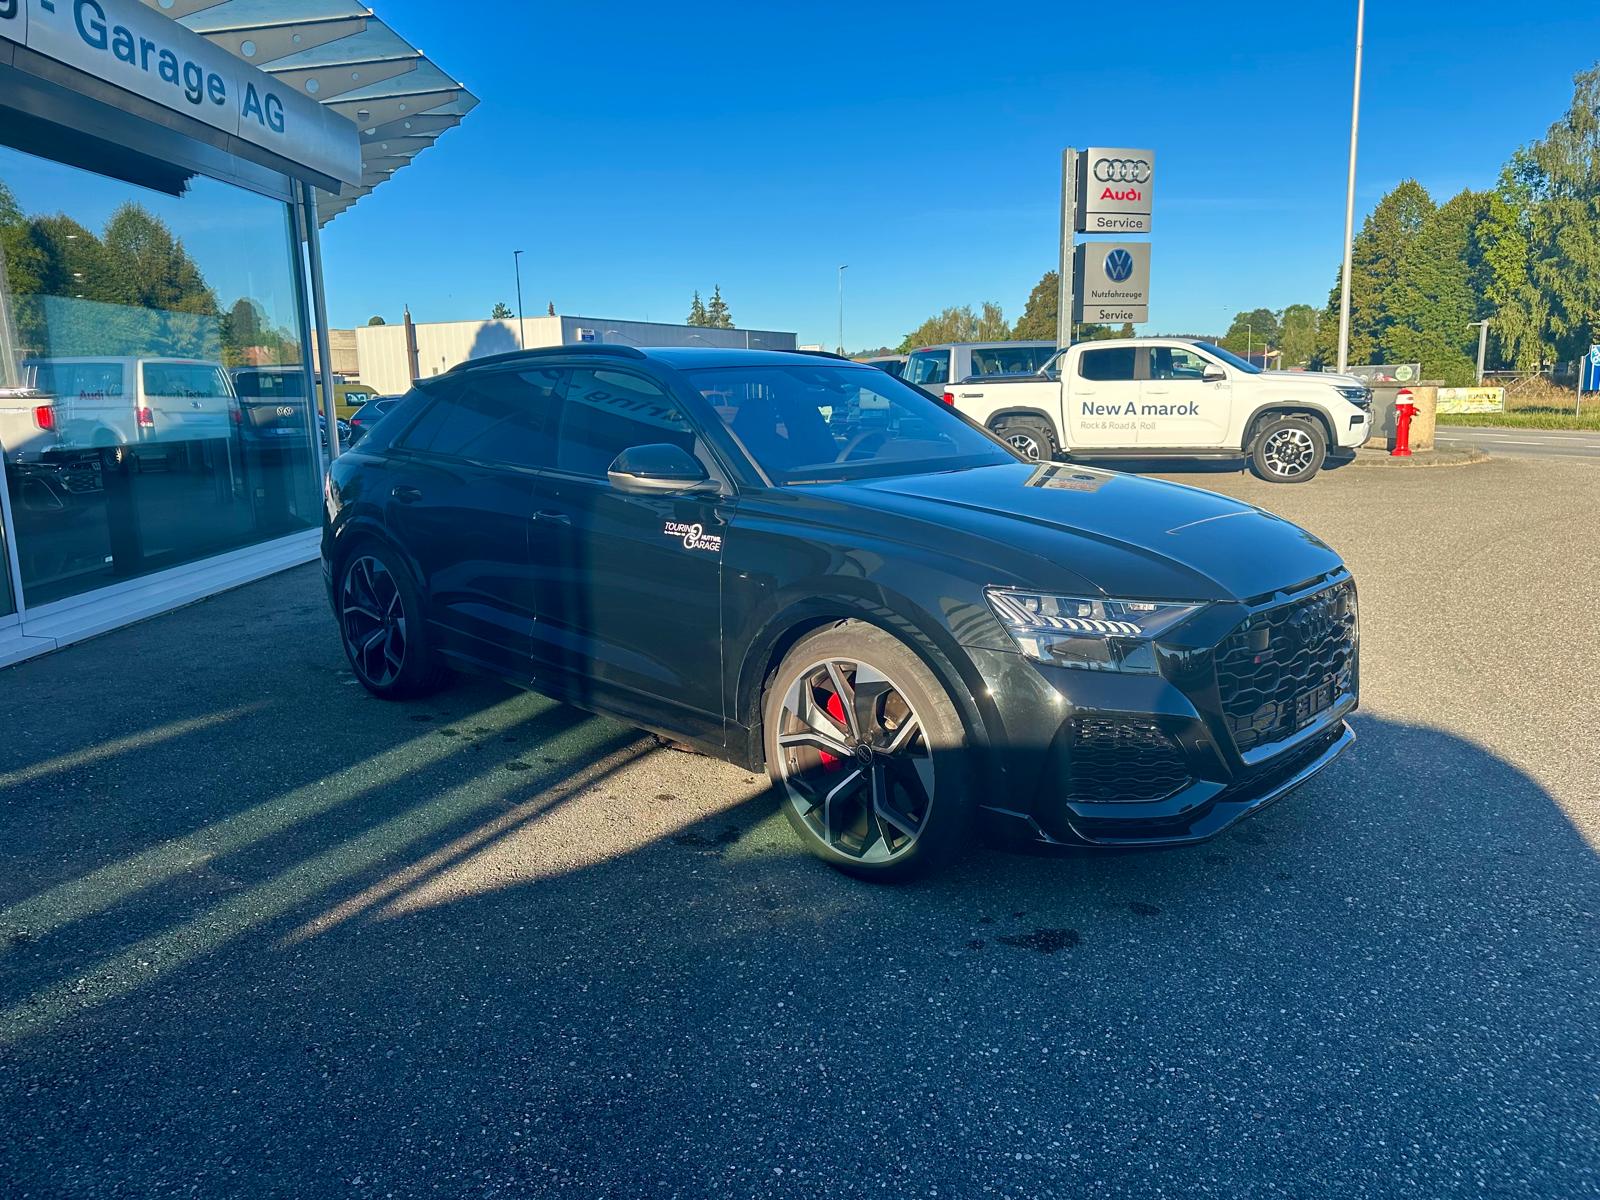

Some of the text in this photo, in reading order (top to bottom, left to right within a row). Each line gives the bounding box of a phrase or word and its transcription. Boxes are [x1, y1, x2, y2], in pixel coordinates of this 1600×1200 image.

[74, 0, 226, 105] Garage
[242, 82, 285, 134] AG
[1100, 187, 1142, 201] Audi
[1097, 217, 1143, 229] Service
[1091, 290, 1142, 299] Nutzfahrzeuge
[1099, 310, 1134, 320] Service
[1082, 401, 1121, 416] New
[1080, 421, 1100, 430] Rock
[1108, 421, 1130, 430] Road
[1140, 421, 1156, 430] Roll
